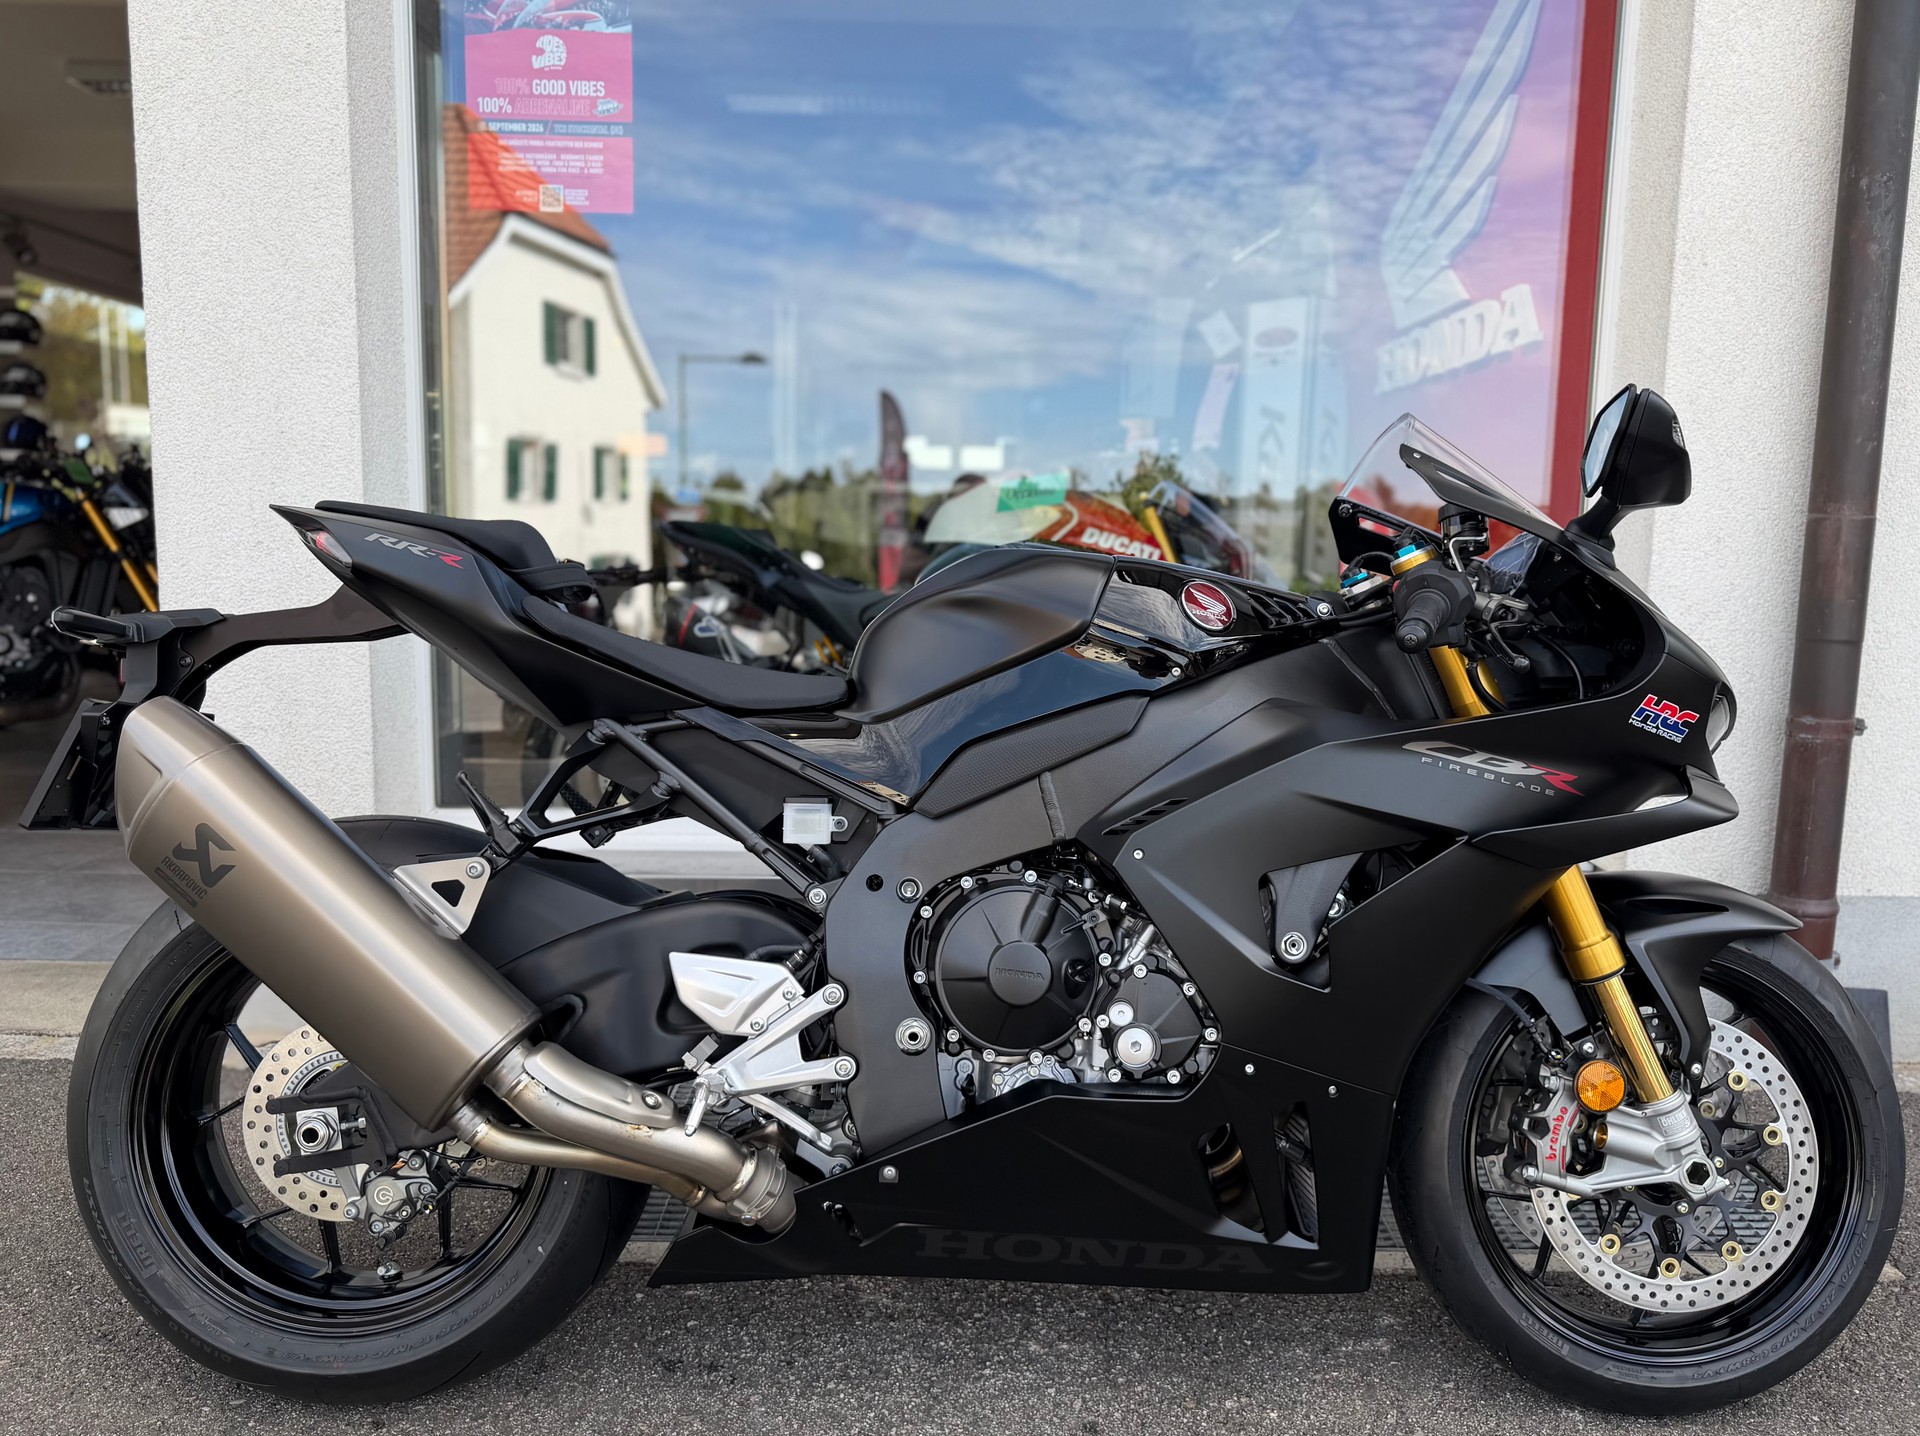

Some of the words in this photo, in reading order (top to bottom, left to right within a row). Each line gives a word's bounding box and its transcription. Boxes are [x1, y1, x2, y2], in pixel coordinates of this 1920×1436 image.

[531, 53, 567, 70] VIBES
[495, 77, 530, 95] 100%
[532, 79, 566, 96] GOOD
[569, 80, 605, 97] VIBES
[477, 97, 512, 114] 100%
[514, 98, 592, 116] ADRENALINE
[488, 121, 527, 132] SEPTEMBER
[364, 533, 465, 570] RR-R
[1081, 526, 1163, 561] DUCATI
[1191, 608, 1229, 622] HONDA
[1628, 717, 1657, 734] Honda
[1656, 728, 1683, 744] RACING
[1630, 693, 1700, 738] HRC
[1402, 741, 1585, 797] CBR
[1421, 756, 1556, 797] FIREBLADE
[995, 966, 1045, 981] HONDA
[1544, 1105, 1569, 1162] brembo
[917, 1226, 1273, 1275] HONDA
[1840, 1230, 1868, 1284] 120/70
[167, 1320, 233, 1364] DIABLO
[1518, 1312, 1570, 1357] PIRELLI
